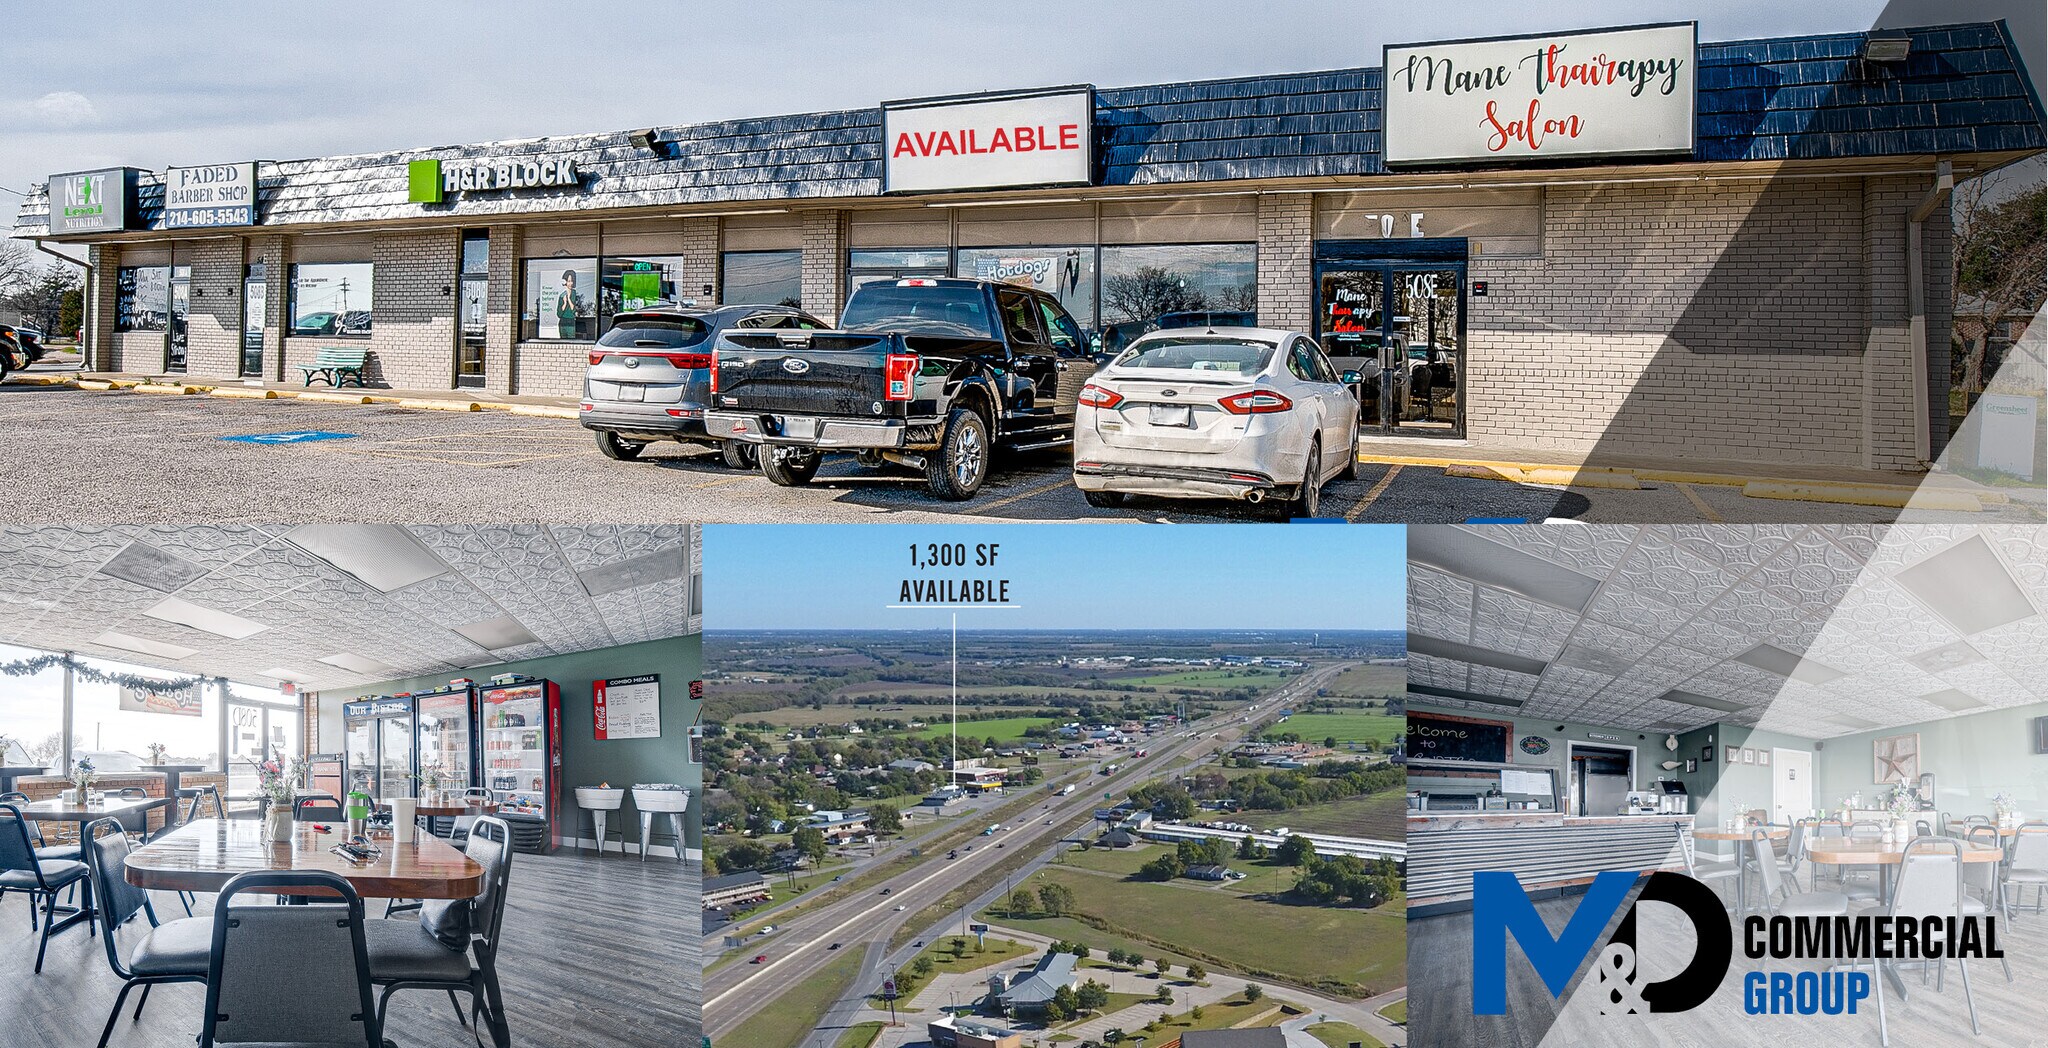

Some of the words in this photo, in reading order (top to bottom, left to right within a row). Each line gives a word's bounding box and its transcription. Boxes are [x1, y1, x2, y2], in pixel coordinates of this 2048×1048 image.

[1393, 54, 1511, 96] Mane
[1479, 98, 1585, 152] Salon
[893, 124, 1080, 159] AVAILABLE
[181, 165, 238, 188] FADED
[444, 166, 490, 192] H&R
[496, 160, 577, 189] BLOCK
[64, 174, 105, 207] NEXT
[171, 187, 213, 204] BARBER
[217, 185, 248, 202] SHOP
[65, 216, 104, 229] NUTRITION
[168, 207, 249, 226] 214-605-5543
[634, 262, 652, 271] OPEN
[987, 258, 1051, 284] Hotdogs
[1336, 288, 1367, 302] Mane
[1405, 274, 1438, 299] 508E
[1334, 320, 1367, 333] Salon
[633, 675, 655, 683] MEALS
[349, 705, 367, 716] OUR
[1420, 739, 1437, 749] to
